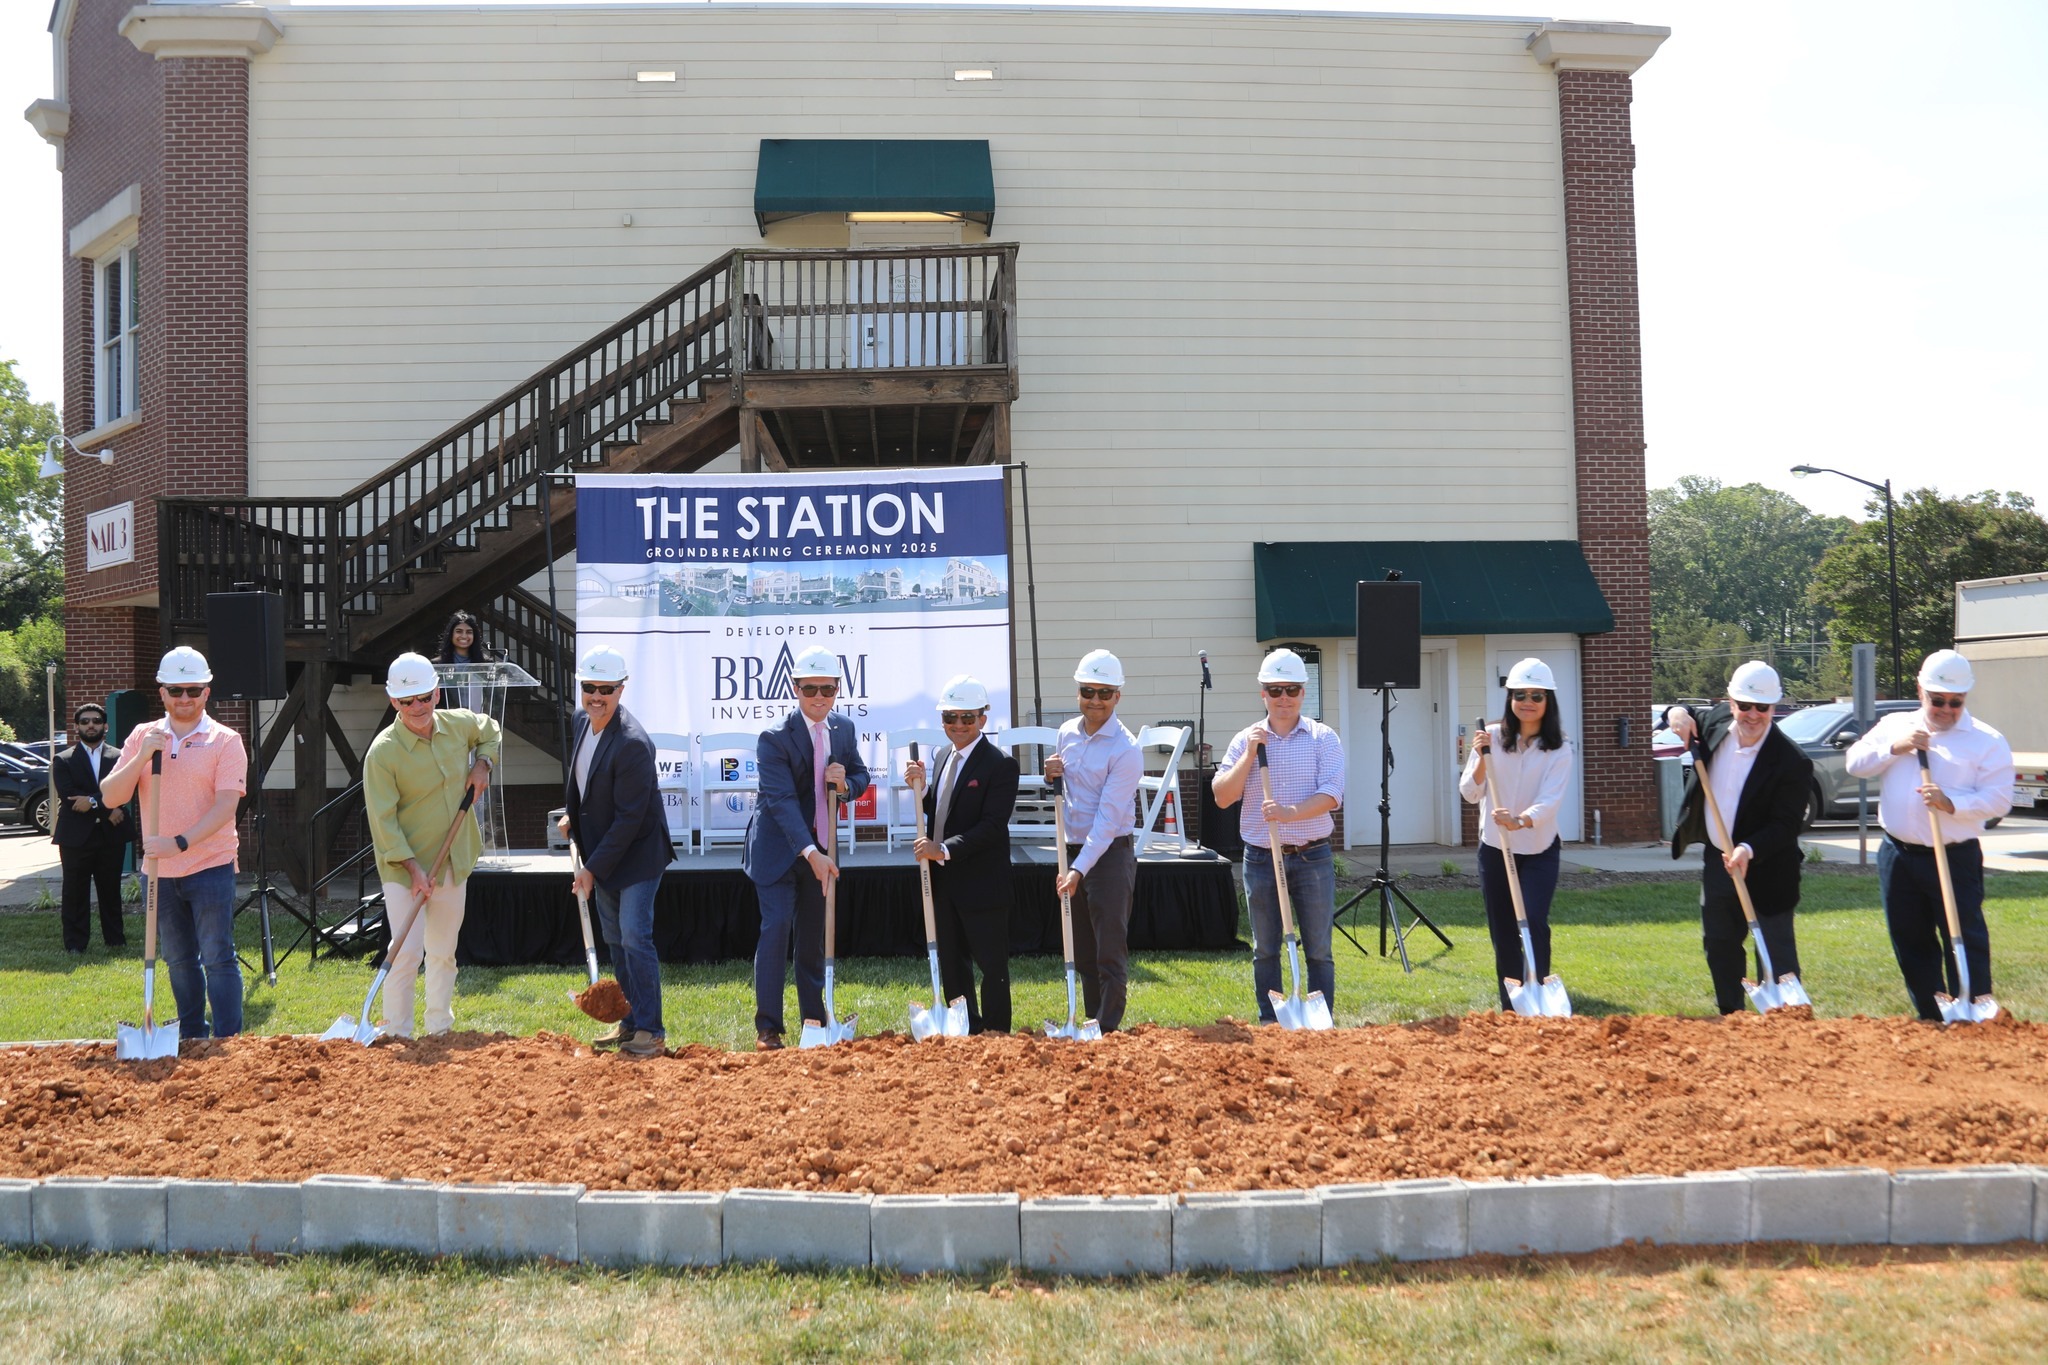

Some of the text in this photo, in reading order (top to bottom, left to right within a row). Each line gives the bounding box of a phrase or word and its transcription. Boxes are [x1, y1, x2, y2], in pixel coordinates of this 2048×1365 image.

[636, 491, 945, 540] THE STATION
[90, 517, 127, 555] NAIL 3
[645, 542, 938, 559] GROUNDBREAKING CEREMONY 2025
[726, 624, 854, 637] DEVELOPED BY:
[711, 640, 869, 701] BRAM
[712, 703, 868, 720] INVESTTS
[1278, 860, 1286, 888] CRAFTSMAN
